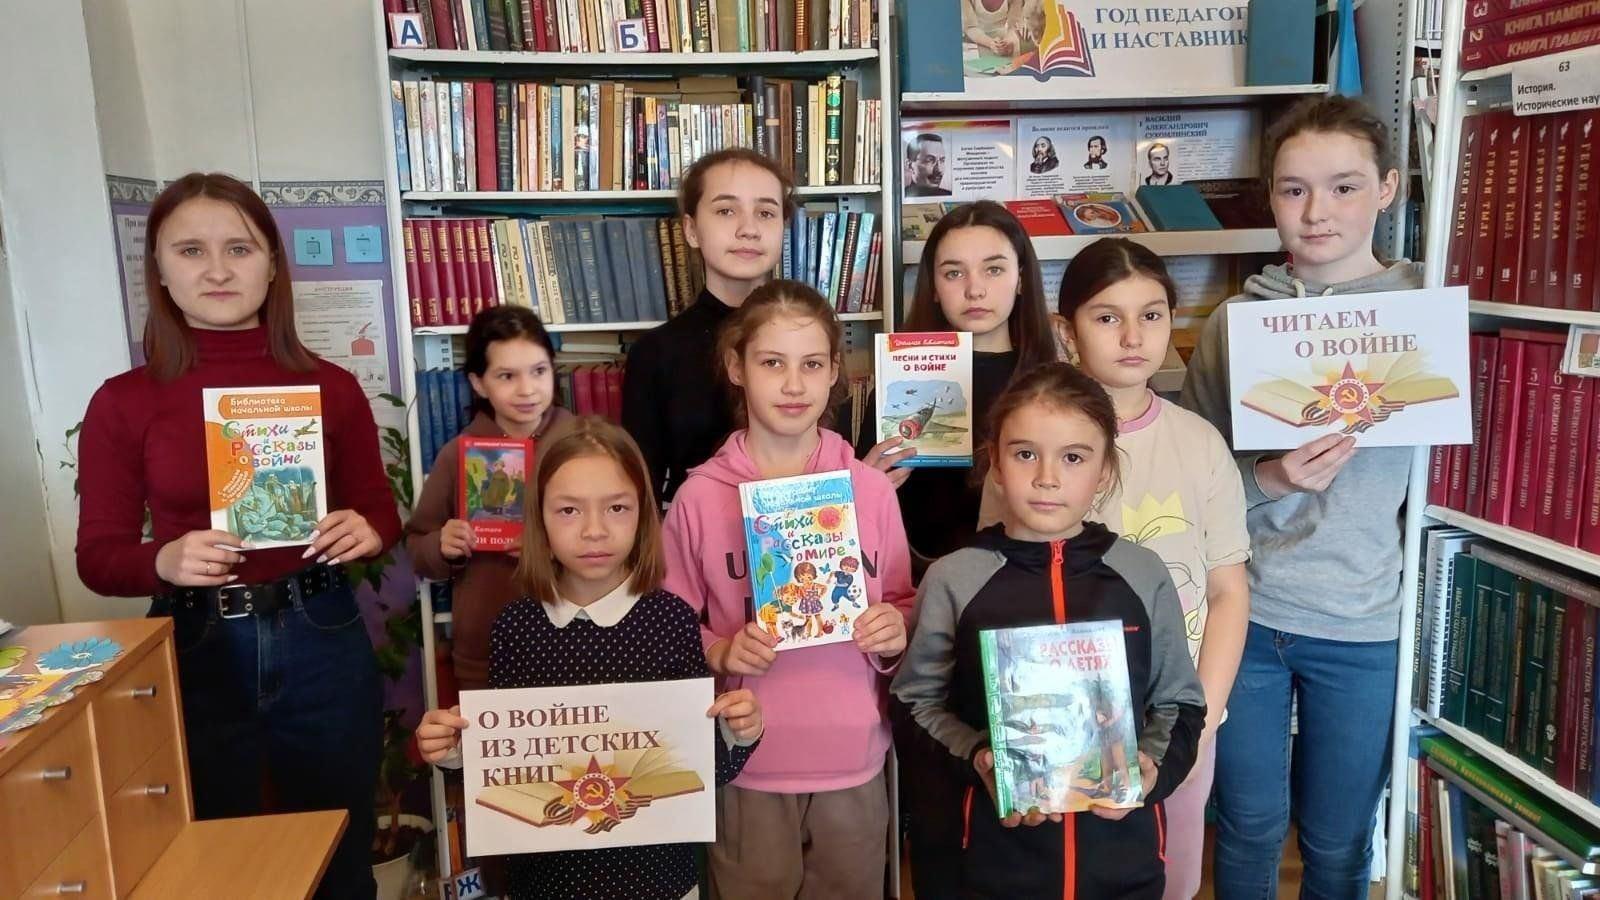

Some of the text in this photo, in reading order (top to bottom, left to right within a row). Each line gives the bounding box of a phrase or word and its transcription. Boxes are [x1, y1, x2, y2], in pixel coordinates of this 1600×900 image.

[1096, 8, 1140, 26] ГОД
[1473, 3, 1488, 17] 3
[400, 19, 423, 45] А
[1469, 28, 1484, 43] 2
[1504, 14, 1544, 36] КНИГА
[620, 23, 639, 49] Б
[1091, 33, 1107, 49] И
[1507, 25, 1600, 57] КНИГА ПАМЯТ
[1558, 61, 1571, 72] 63
[1517, 83, 1556, 96] История.
[1516, 97, 1579, 111] Исторические
[1456, 202, 1467, 237] ТЫЛА
[1480, 202, 1491, 237] ТЫЛА
[1504, 202, 1516, 239] ТЫЛА
[1533, 202, 1543, 240] ТЫЛА
[1552, 201, 1562, 239] ТЫЛА
[1575, 201, 1587, 239] ТЫЛА
[1573, 274, 1582, 285] 15
[1262, 309, 1378, 334] ЧИТАЕМ
[1295, 332, 1418, 358] О ВОЙНЕ
[914, 362, 947, 371] ВОЙНЕ
[1530, 367, 1539, 382] 5
[1553, 370, 1562, 385] 6
[230, 397, 286, 407] Библиотека
[231, 404, 281, 415] начальной
[222, 421, 289, 438] Стихи
[240, 453, 302, 468] о войне
[754, 514, 814, 535] Стихи
[796, 546, 846, 561] о мире
[1584, 636, 1593, 693] СТАТИСТИКА
[478, 703, 610, 729] О ВОЙНЕ
[480, 730, 661, 760] ИЗ ДЕТСКИХ
[482, 764, 563, 788] КНИГ
[457, 873, 482, 897] Ж
